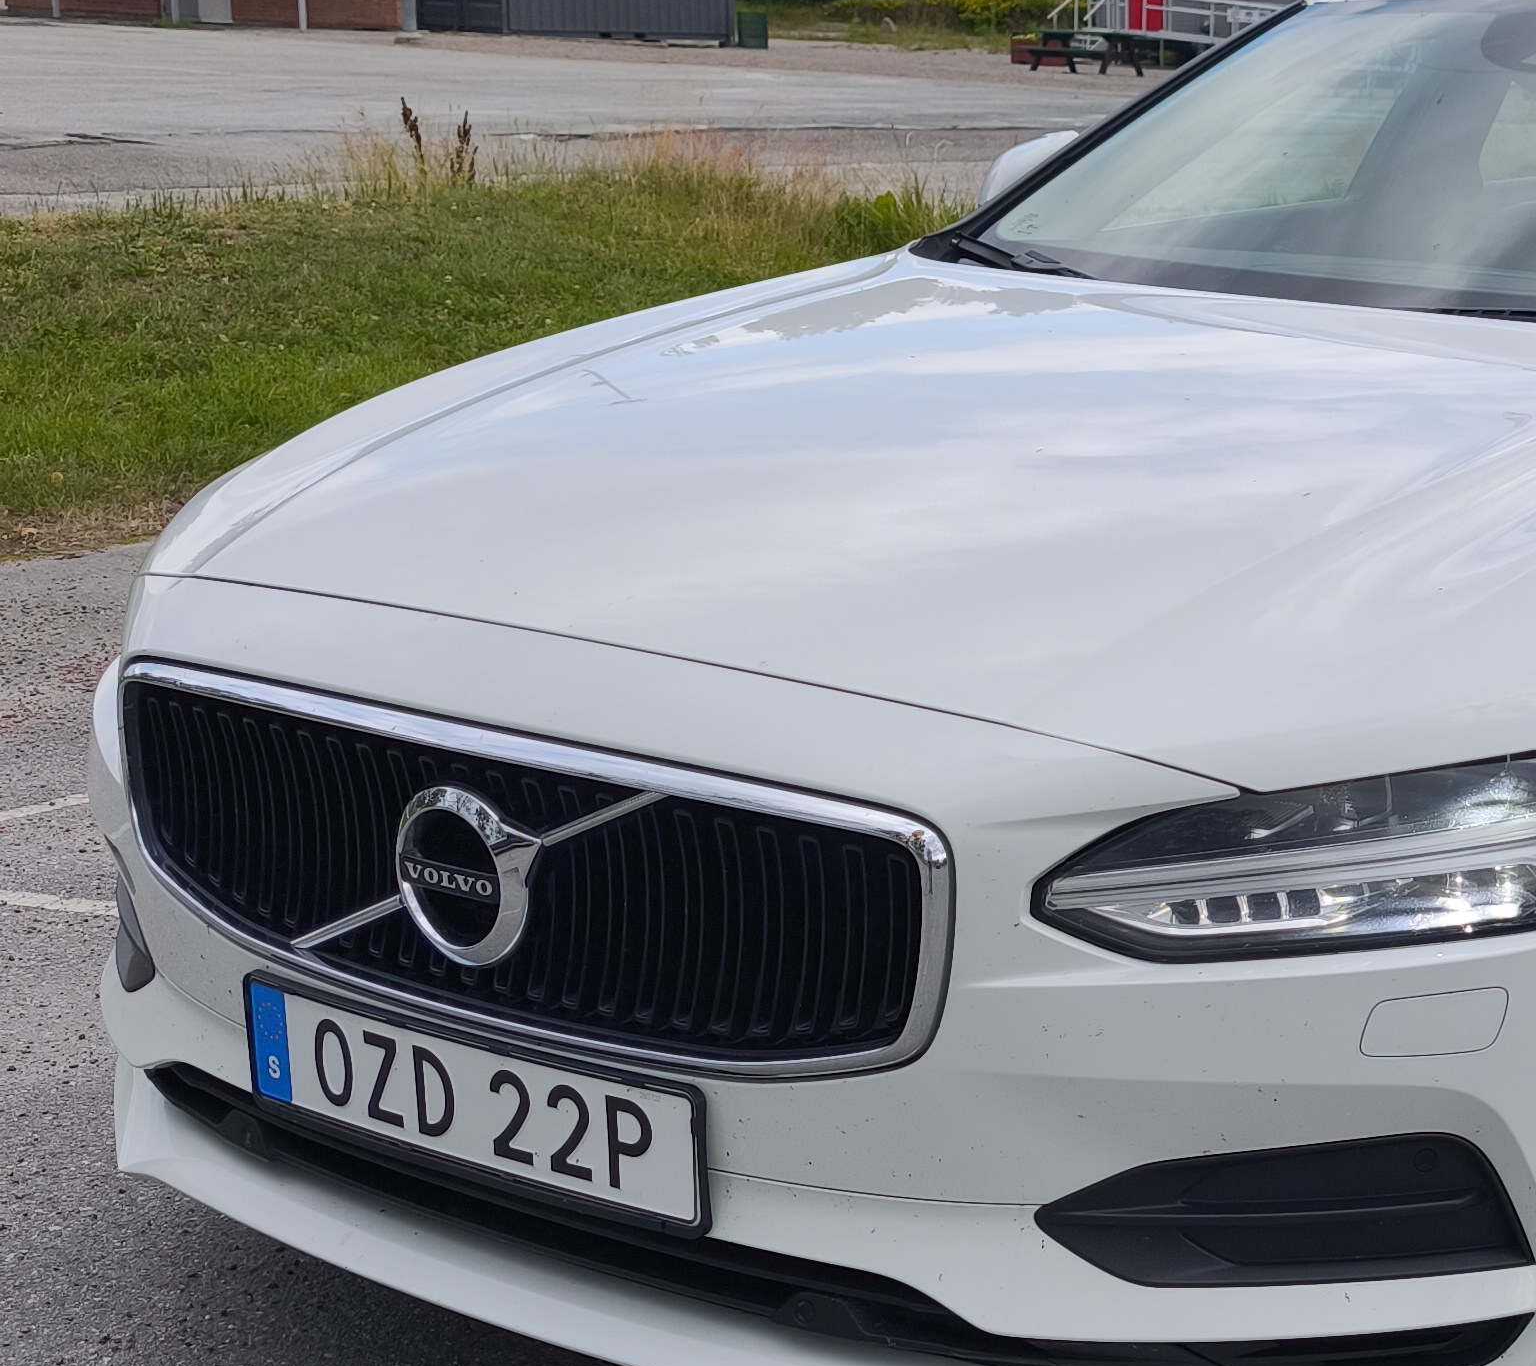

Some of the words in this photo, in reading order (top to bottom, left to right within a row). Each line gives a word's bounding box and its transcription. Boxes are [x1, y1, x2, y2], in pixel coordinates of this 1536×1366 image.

[404, 861, 493, 896] VOLVO
[268, 1055, 281, 1079] S
[315, 1018, 455, 1138] OZD
[489, 1069, 653, 1190] 22P
